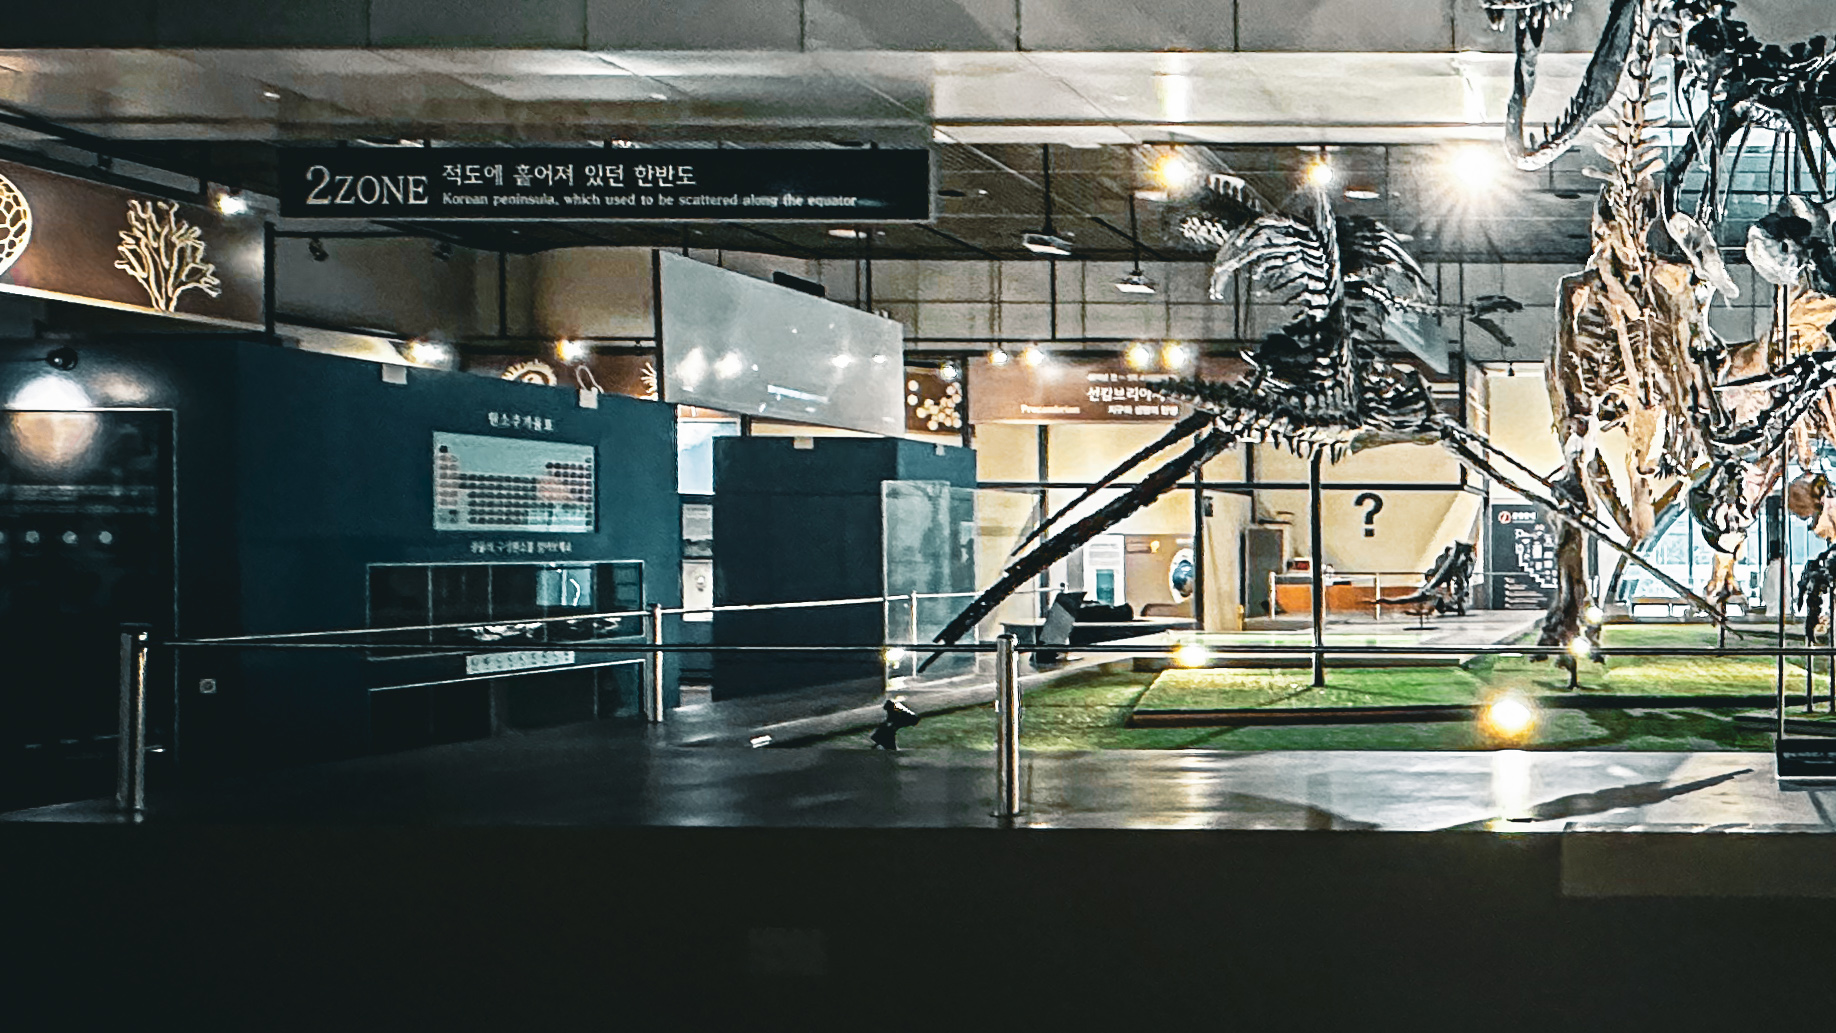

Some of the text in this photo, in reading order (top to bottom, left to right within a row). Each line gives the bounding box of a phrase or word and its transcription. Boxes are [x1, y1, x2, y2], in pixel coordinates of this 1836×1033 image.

[442, 164, 503, 186] 적도에
[585, 164, 625, 188] 있던
[634, 164, 697, 188] 한반도
[442, 192, 489, 205] Korean
[563, 192, 601, 205] which
[604, 193, 636, 206] used
[640, 194, 654, 206] to
[658, 193, 675, 206] be
[678, 193, 739, 207] scattered
[742, 194, 779, 209] along
[782, 193, 804, 207] the
[807, 195, 858, 209] equator
[1354, 492, 1383, 538] ?
